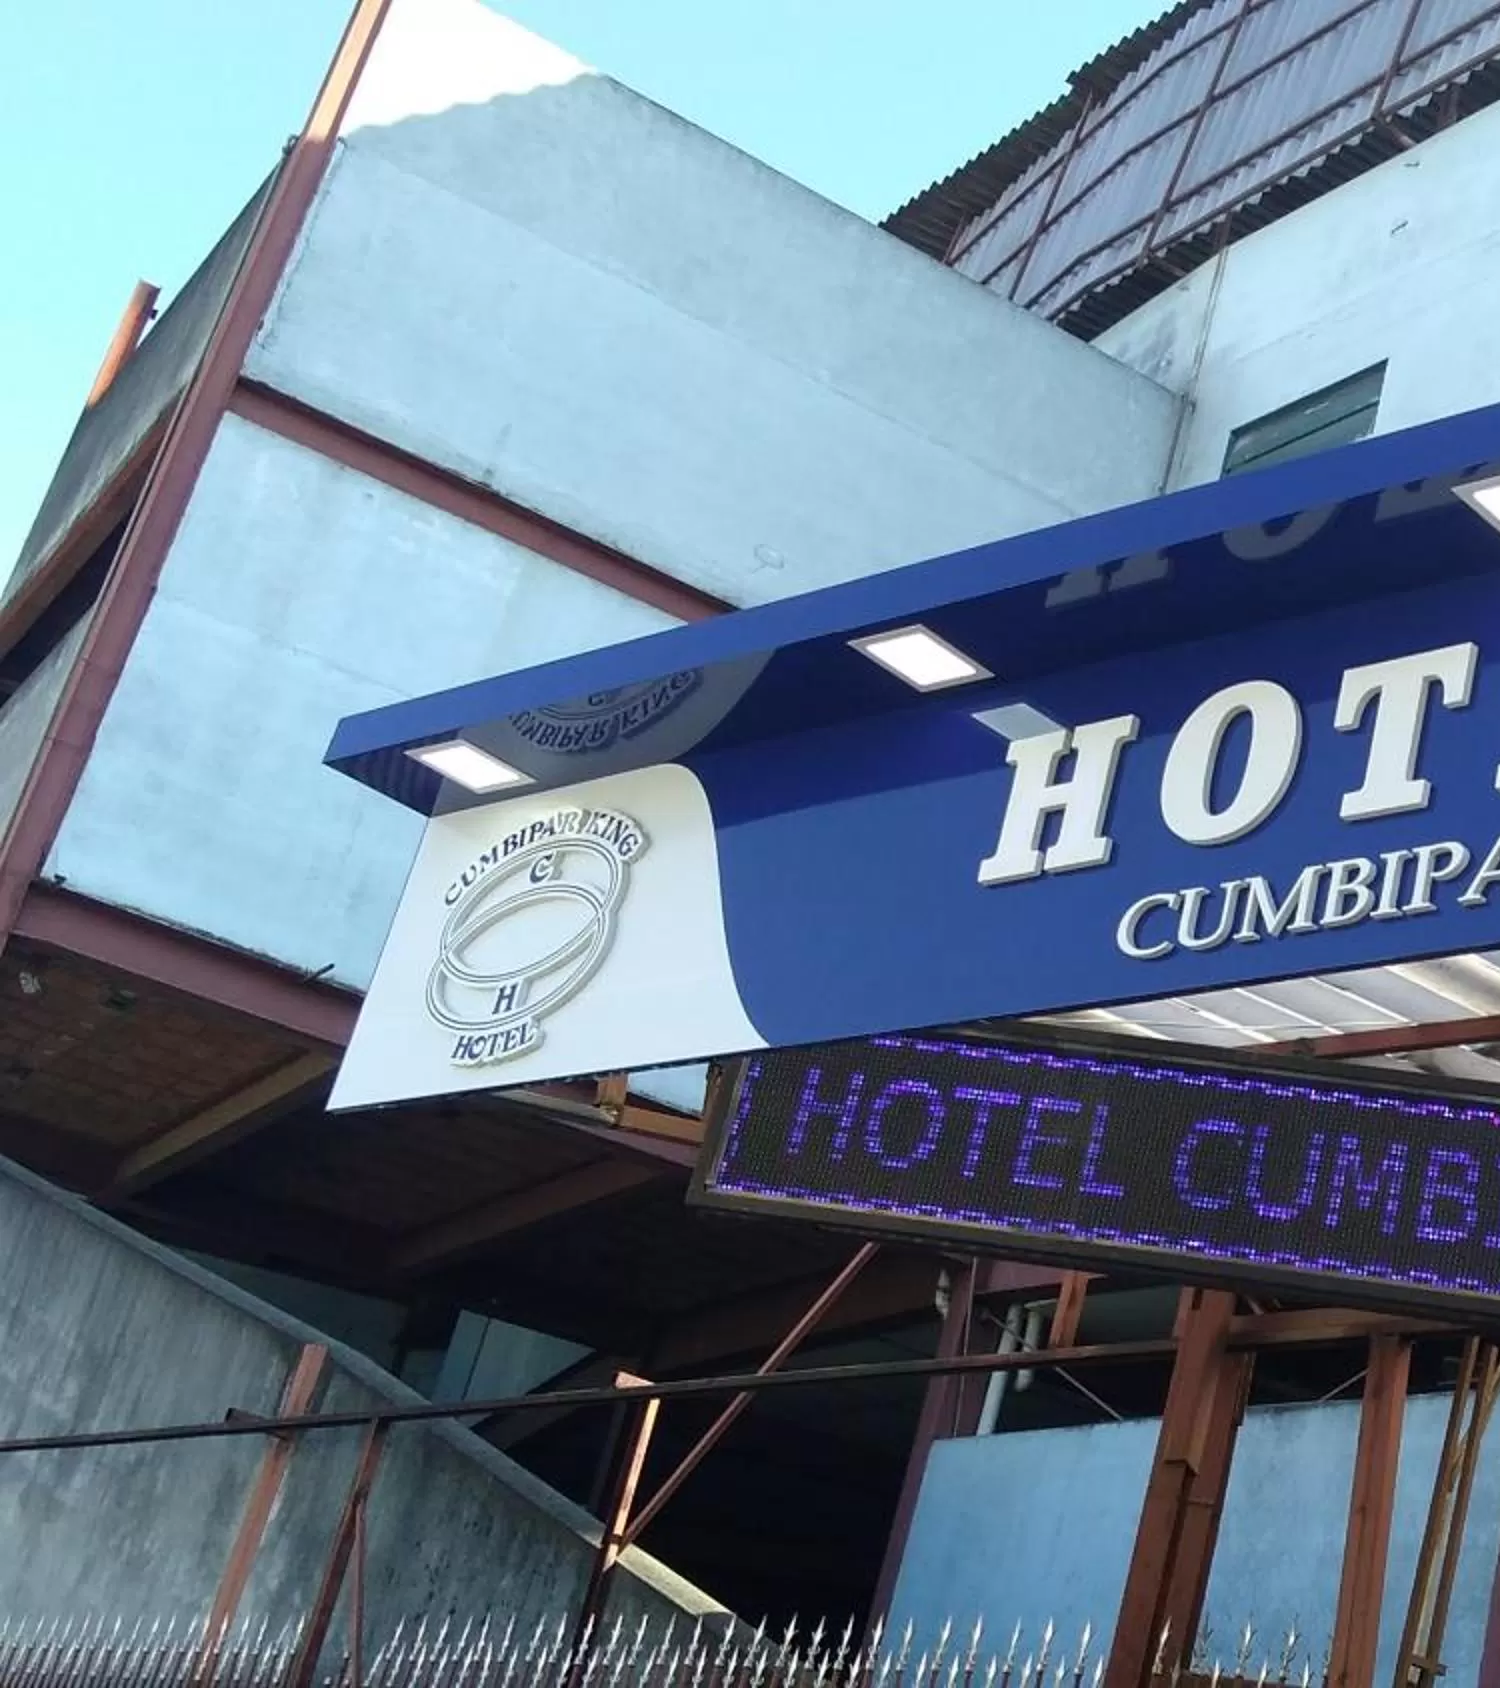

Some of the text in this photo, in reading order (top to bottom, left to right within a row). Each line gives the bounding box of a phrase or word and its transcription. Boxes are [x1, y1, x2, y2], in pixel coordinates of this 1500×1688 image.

[444, 810, 640, 906] CUMBIPAR KING
[529, 854, 553, 884] C
[492, 982, 519, 1016] H
[450, 1022, 535, 1061] HOTEL
[787, 1066, 1125, 1198] HOTEL
